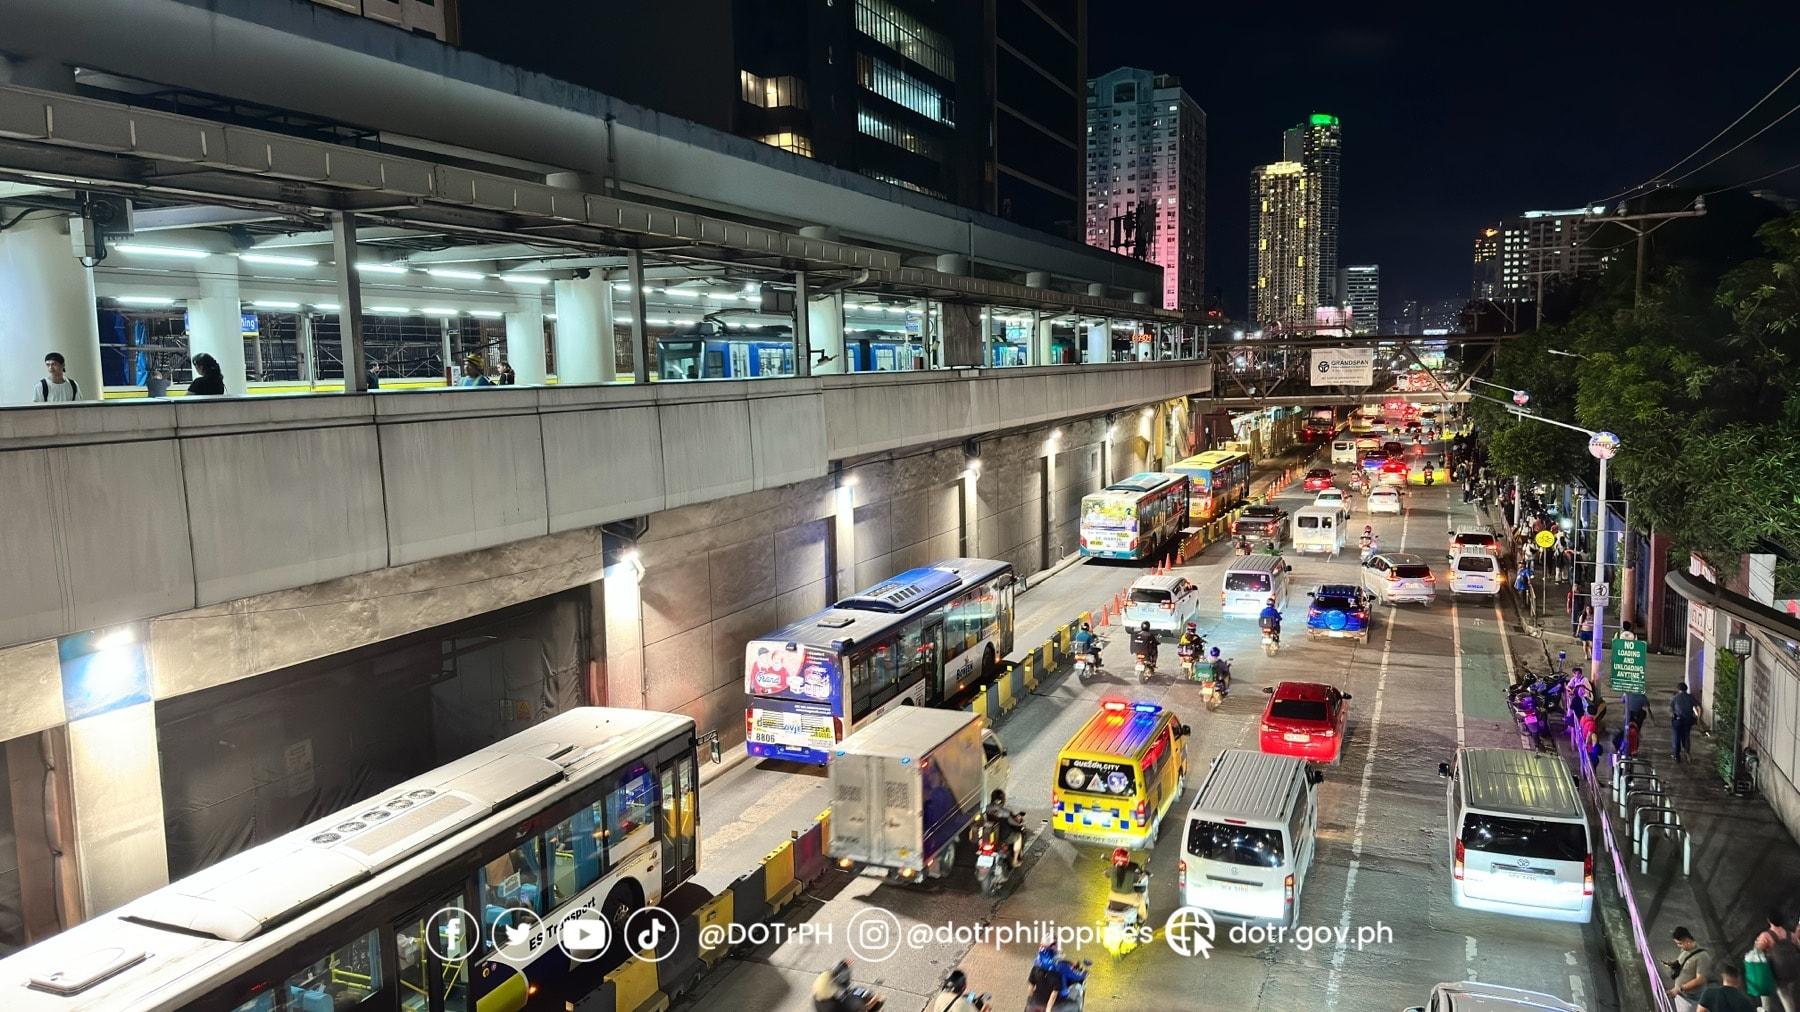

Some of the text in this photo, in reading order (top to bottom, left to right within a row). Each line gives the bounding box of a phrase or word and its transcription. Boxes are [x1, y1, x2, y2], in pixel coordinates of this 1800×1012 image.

[1624, 641, 1634, 650] NO
[1617, 650, 1640, 658] LOADING
[1613, 663, 1643, 672] UNLOADING
[1617, 671, 1640, 679] ANYTIME
[756, 733, 775, 743] 8806
[1073, 760, 1103, 769] QUEZON
[529, 932, 543, 951] ES
